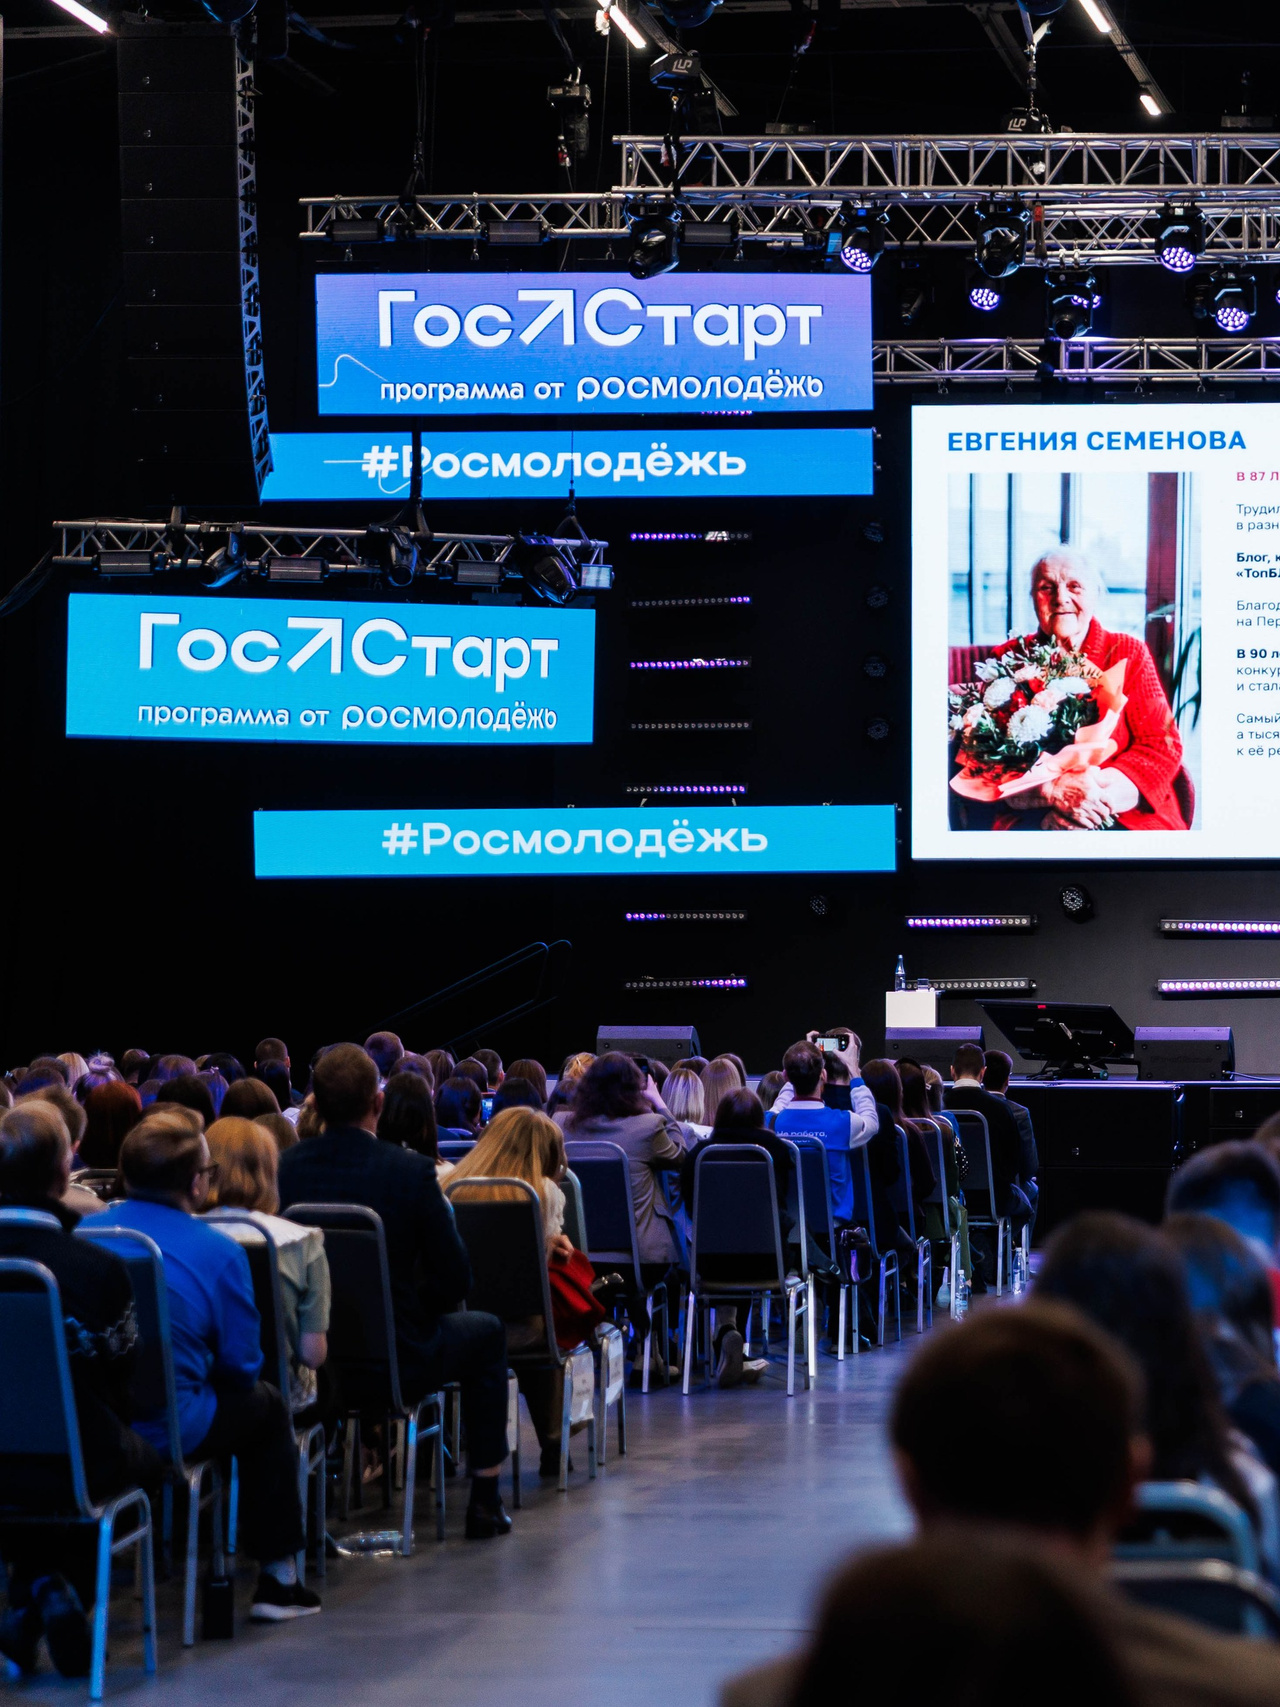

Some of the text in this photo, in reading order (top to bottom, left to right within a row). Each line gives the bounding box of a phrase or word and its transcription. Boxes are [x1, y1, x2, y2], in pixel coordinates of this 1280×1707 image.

[381, 369, 823, 403] программа от росмолодёжь
[947, 429, 1247, 452] ЕВГЕНИЯ СЕМЕНОВА
[1236, 471, 1246, 482] В
[1249, 471, 1266, 482] 87
[1235, 521, 1244, 531] в
[1236, 617, 1253, 627] на
[1236, 647, 1247, 659] В
[1249, 647, 1268, 660] 90
[1236, 683, 1245, 692] и
[138, 701, 557, 732] программа от росмолодёжь
[1236, 731, 1245, 740] а
[1236, 747, 1245, 756] к
[1247, 745, 1265, 757] её
[381, 819, 768, 858] #Росмолодёжь
